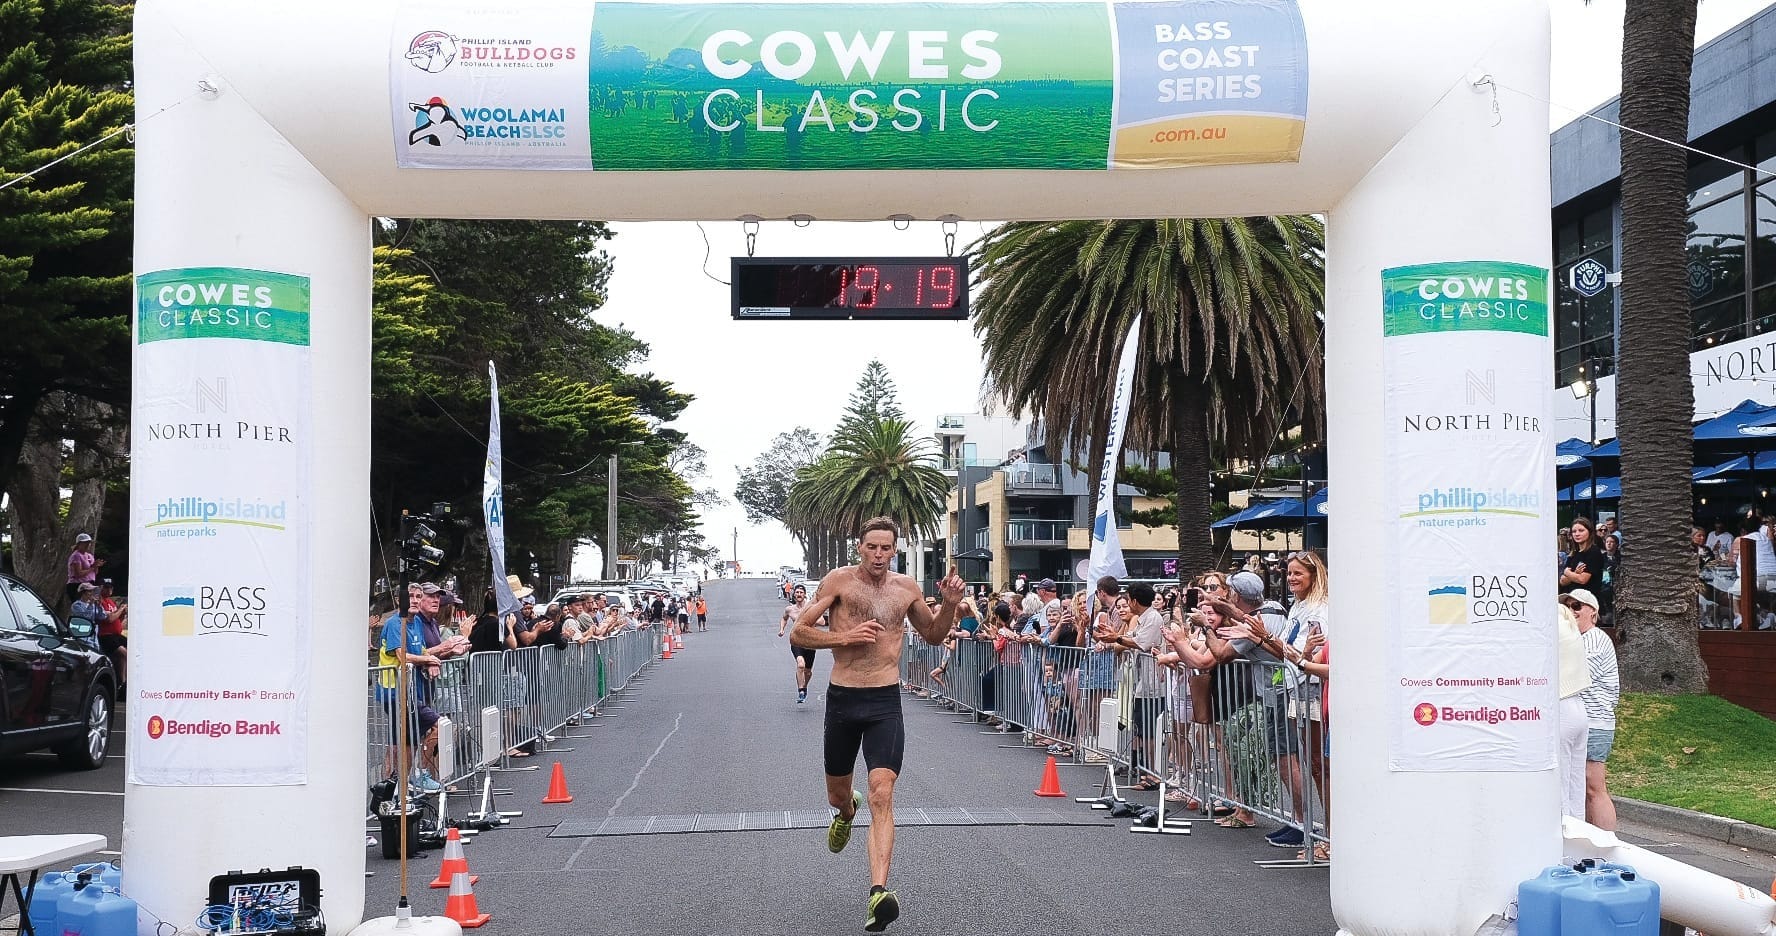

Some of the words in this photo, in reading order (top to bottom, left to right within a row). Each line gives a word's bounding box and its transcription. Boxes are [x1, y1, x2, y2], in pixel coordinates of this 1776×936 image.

[1155, 21, 1232, 43] BASS
[460, 46, 576, 60] BULLDOGS
[701, 29, 1002, 81] COWES
[1157, 44, 1261, 72] COAST
[1157, 75, 1262, 104] SERIES
[461, 107, 565, 123] WOOLAMAI
[703, 87, 1000, 134] CLASSIC
[464, 124, 566, 139] BEACHSLSC
[1149, 126, 1227, 145] .com.au
[1577, 262, 1603, 275] FURPHY
[158, 283, 273, 308] COWES
[1418, 277, 1528, 301] COWES
[159, 307, 272, 329] CLASSIC
[1420, 301, 1529, 321] CLASSIC
[148, 422, 221, 441] NORTH
[237, 421, 293, 443] PIER
[1404, 414, 1491, 433] NORTH
[1503, 412, 1541, 432] PIER
[157, 496, 287, 523] phillipisland
[157, 527, 186, 538] nature
[187, 527, 217, 539] parks
[1418, 517, 1455, 527] nature
[1457, 517, 1487, 529] parks
[1472, 575, 1528, 599] BASS
[200, 585, 267, 611] BASS
[1473, 600, 1528, 617] COAST
[200, 612, 266, 630] COAST
[1400, 677, 1433, 687] Cowes
[1435, 677, 1495, 688] Community
[1526, 676, 1548, 687] Branch
[140, 689, 163, 700] Cowes
[164, 689, 219, 701] Community
[260, 690, 295, 700] Branch
[1442, 706, 1507, 725] Bendigo
[1509, 706, 1541, 722] Bank
[167, 719, 231, 738] Bendigo
[235, 720, 281, 735] Bank
